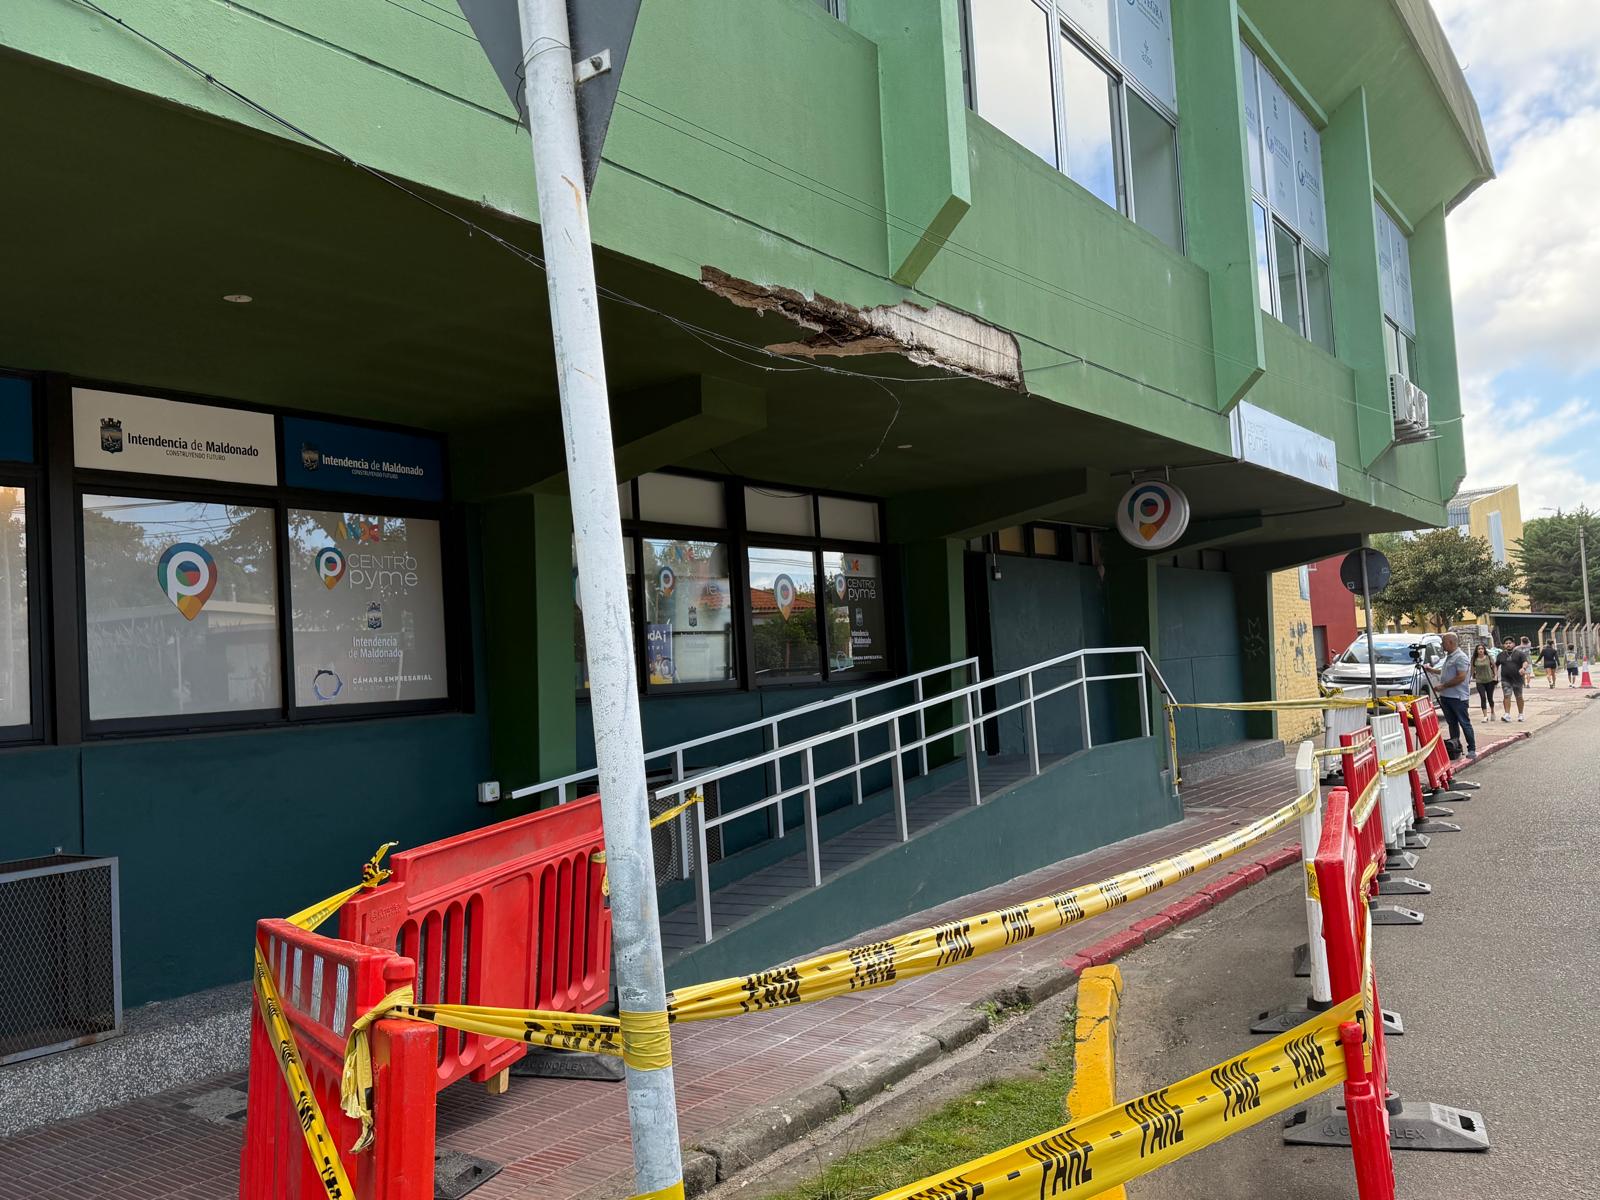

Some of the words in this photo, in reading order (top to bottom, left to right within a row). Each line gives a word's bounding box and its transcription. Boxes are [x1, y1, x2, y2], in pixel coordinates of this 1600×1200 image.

[128, 432, 188, 449] Intendencia
[190, 439, 203, 451] de
[205, 441, 259, 457] Maldonado
[322, 454, 369, 470] Intendencia
[370, 460, 380, 470] de
[382, 462, 424, 476] Maldonado
[348, 553, 418, 571] CENTRO
[349, 570, 418, 590] pyme
[847, 578, 876, 588] CENTRO
[848, 588, 877, 600] pyme
[353, 635, 398, 647] Intendencia
[348, 648, 359, 658] de
[360, 647, 403, 658] Maldonado
[352, 674, 383, 684] CÁMARA
[384, 673, 433, 683] EMPRESARIAL
